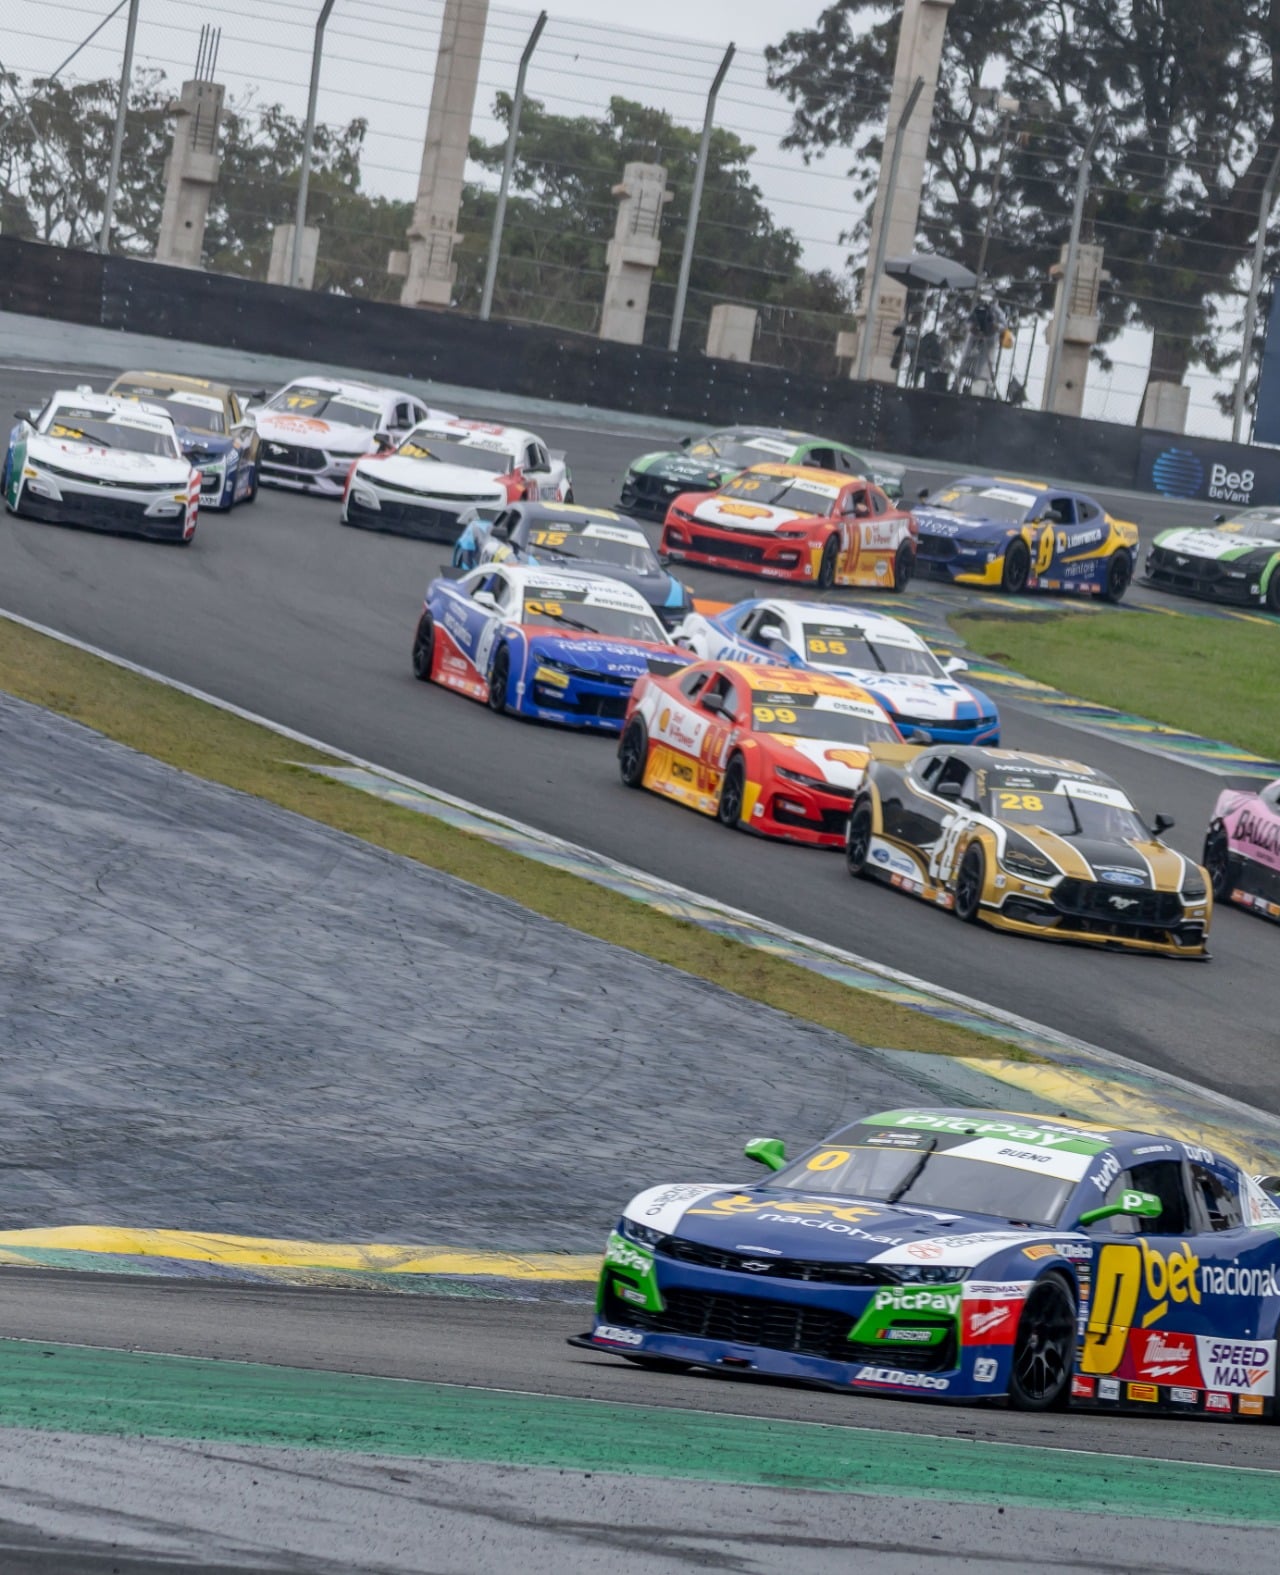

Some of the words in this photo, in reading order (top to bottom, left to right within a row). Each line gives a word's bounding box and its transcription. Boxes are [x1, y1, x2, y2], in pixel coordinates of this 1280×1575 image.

[1210, 462, 1254, 492] Be8
[1208, 484, 1251, 504] BeVant
[534, 532, 567, 546] 15
[809, 639, 847, 655] 85
[753, 707, 797, 723] 99
[834, 702, 874, 715] OSMAN
[1000, 793, 1044, 811] 28
[896, 1115, 1074, 1146] PicPay
[806, 1150, 850, 1172] 0
[997, 1148, 1052, 1163] BUENO
[757, 1213, 905, 1247] nacional
[1139, 1237, 1200, 1305] bet
[875, 1291, 962, 1316] PicPay
[887, 1329, 931, 1342] NASCAR
[1209, 1344, 1269, 1367] SPEED
[854, 1367, 950, 1392] ACDelco
[1213, 1366, 1253, 1388] MAX
